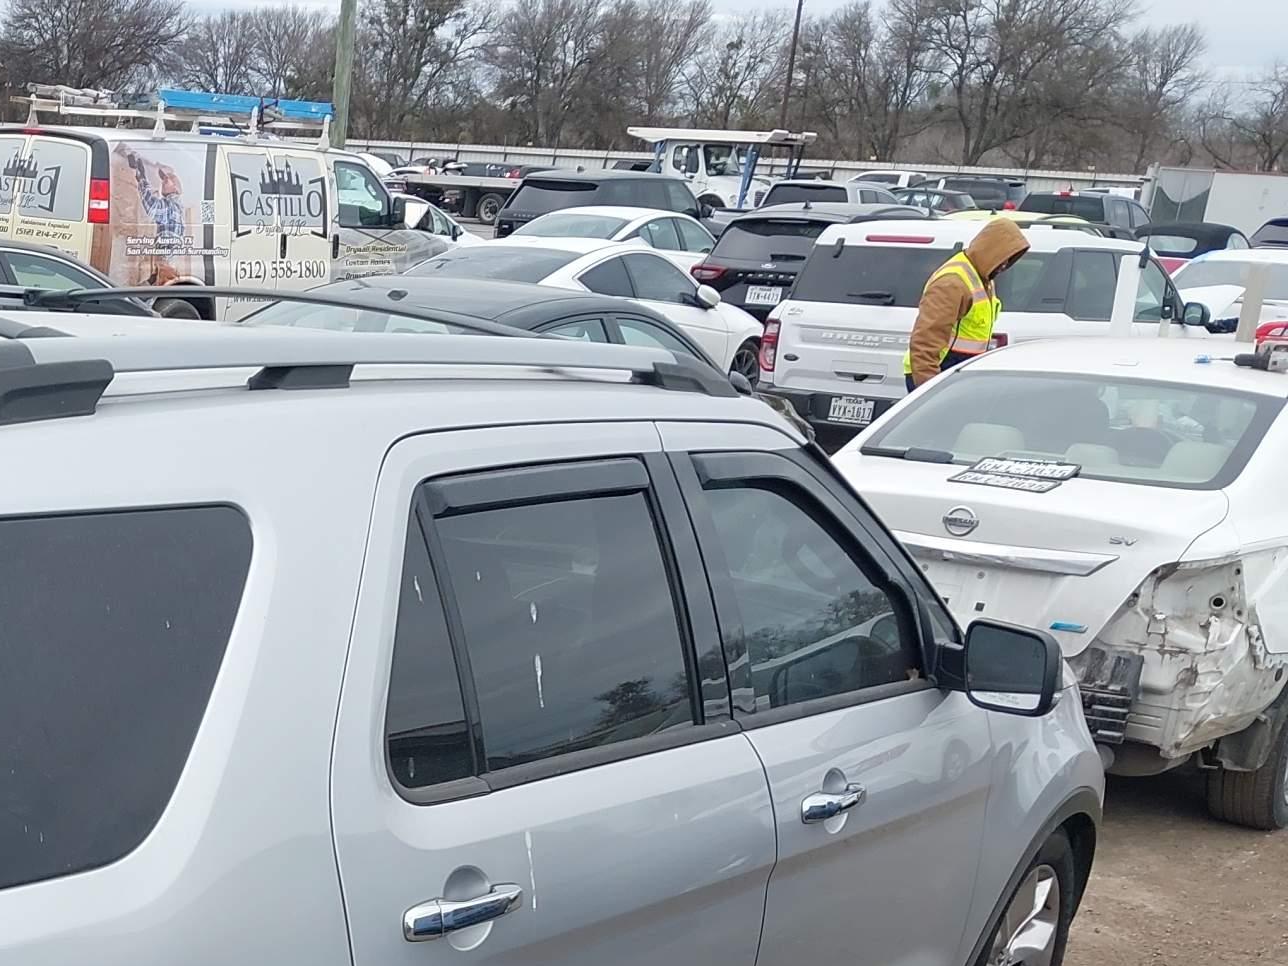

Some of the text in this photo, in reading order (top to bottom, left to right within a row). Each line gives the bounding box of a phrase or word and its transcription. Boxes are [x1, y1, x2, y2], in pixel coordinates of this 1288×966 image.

[239, 190, 323, 217] CASTILLO
[35, 230, 73, 240] 214-2767
[126, 236, 154, 246] Serving
[183, 236, 194, 245] TX
[126, 247, 229, 258] San Antonio and Surrounding
[235, 260, 326, 284] (512) 558-1800
[821, 332, 910, 344] BRONCO
[1109, 535, 1138, 547] SV
